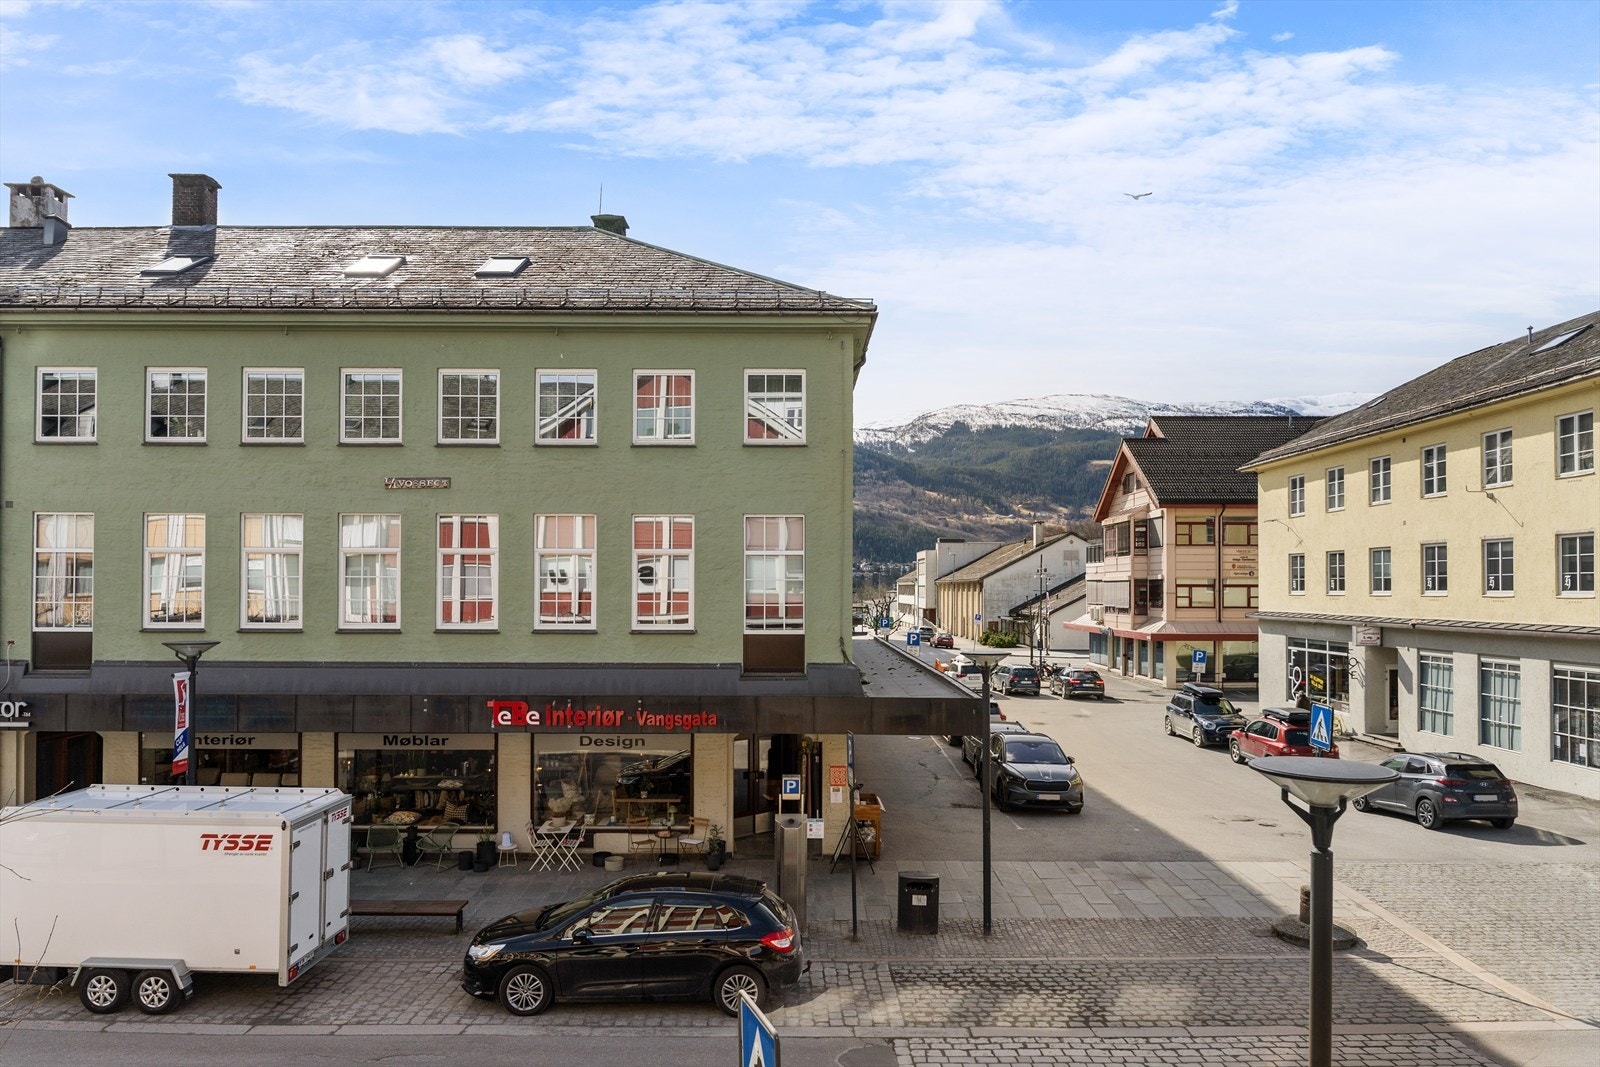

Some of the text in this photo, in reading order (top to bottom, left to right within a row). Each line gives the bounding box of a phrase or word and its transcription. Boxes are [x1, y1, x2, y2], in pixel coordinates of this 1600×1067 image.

[910, 634, 917, 644] P
[1196, 652, 1203, 661] P
[0, 701, 28, 717] or
[487, 700, 540, 727] TeBe
[546, 704, 625, 727] interiør
[636, 709, 717, 730] Vangsgata
[195, 735, 256, 746] nteriør
[383, 735, 449, 746] Møblar
[579, 735, 646, 749] Design
[786, 780, 796, 793] P
[200, 833, 273, 851] TYSSE
